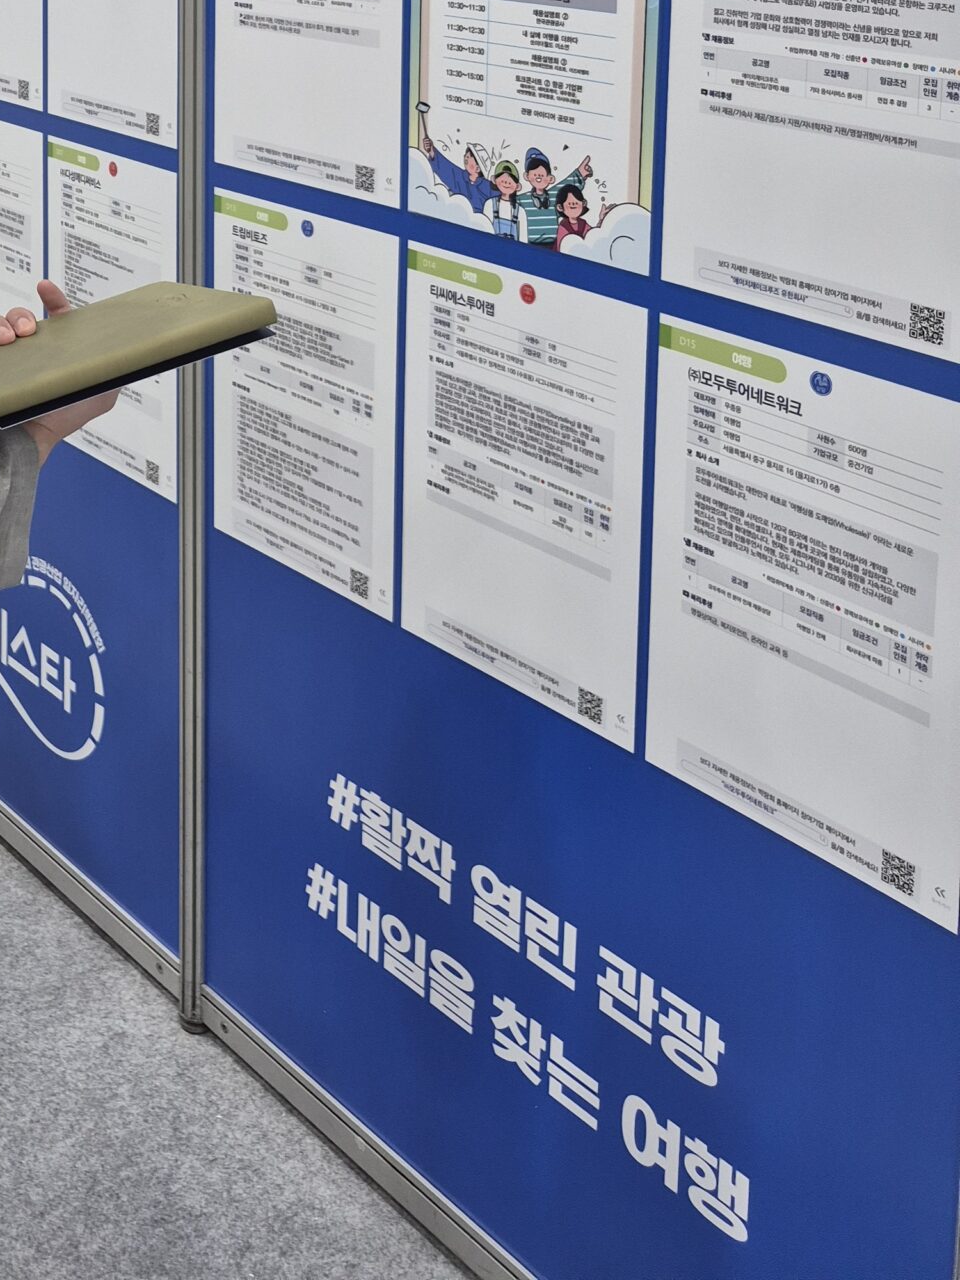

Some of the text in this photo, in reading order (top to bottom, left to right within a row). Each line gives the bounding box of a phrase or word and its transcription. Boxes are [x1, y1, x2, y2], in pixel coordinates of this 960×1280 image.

[447, 1, 485, 12] 10:30~11:30
[927, 1, 955, 13] 크루즈선
[447, 23, 484, 35] 11:30~12:30
[446, 43, 484, 55] 12:30~13:30
[446, 68, 483, 81] 13:30~15:00
[879, 76, 906, 88] 임금조건
[923, 77, 938, 88] 모집
[923, 87, 937, 97] 인원
[445, 94, 483, 107] 15:00~17:00
[232, 224, 267, 246] 트립비토즈
[429, 283, 494, 317] 티씨에스투어랩
[679, 336, 696, 350] D15
[692, 419, 740, 442] 주요사업 여행업
[693, 391, 716, 406] 대표자명
[816, 432, 835, 447] 사원수
[848, 442, 867, 457] 600명
[723, 415, 741, 428] 여행업
[812, 446, 838, 462] 기업규모
[847, 457, 873, 475] 중견기업
[697, 434, 709, 446] 주소
[722, 443, 751, 461] 서울특별시
[752, 454, 764, 466] 중구
[829, 482, 840, 494] 6층
[327, 772, 726, 1087] #활짝 열린 관광
[305, 862, 750, 1242] #내일을 찾는 여행
